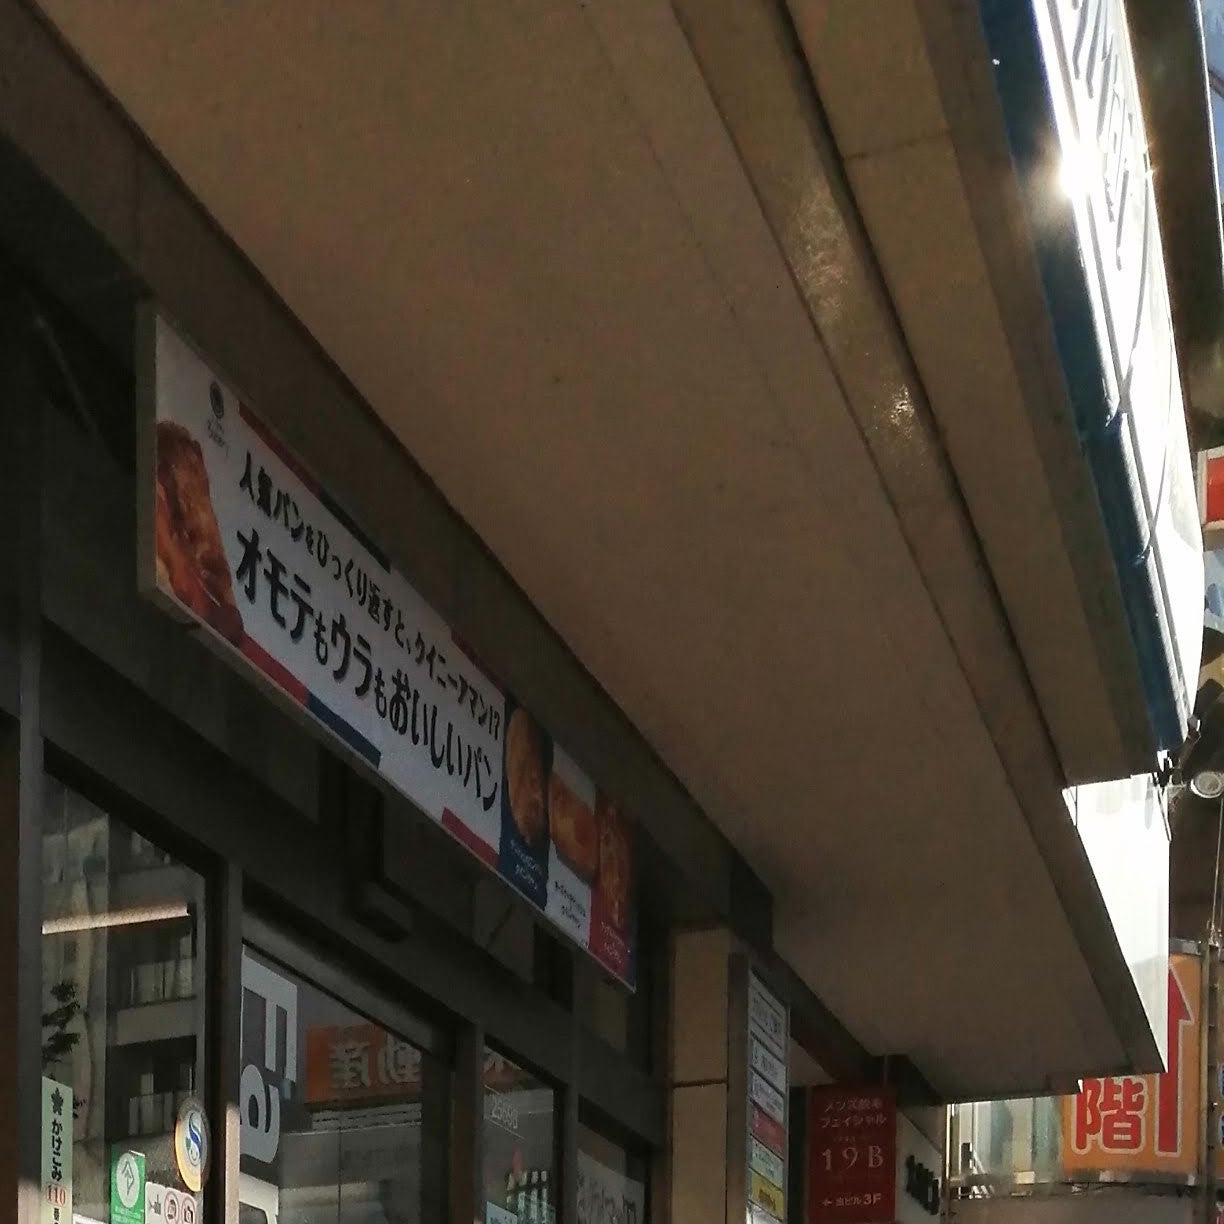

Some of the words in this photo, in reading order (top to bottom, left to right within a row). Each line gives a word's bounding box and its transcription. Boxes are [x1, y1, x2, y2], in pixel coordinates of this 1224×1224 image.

[236, 528, 498, 812] オモテもウラもおいしいパン
